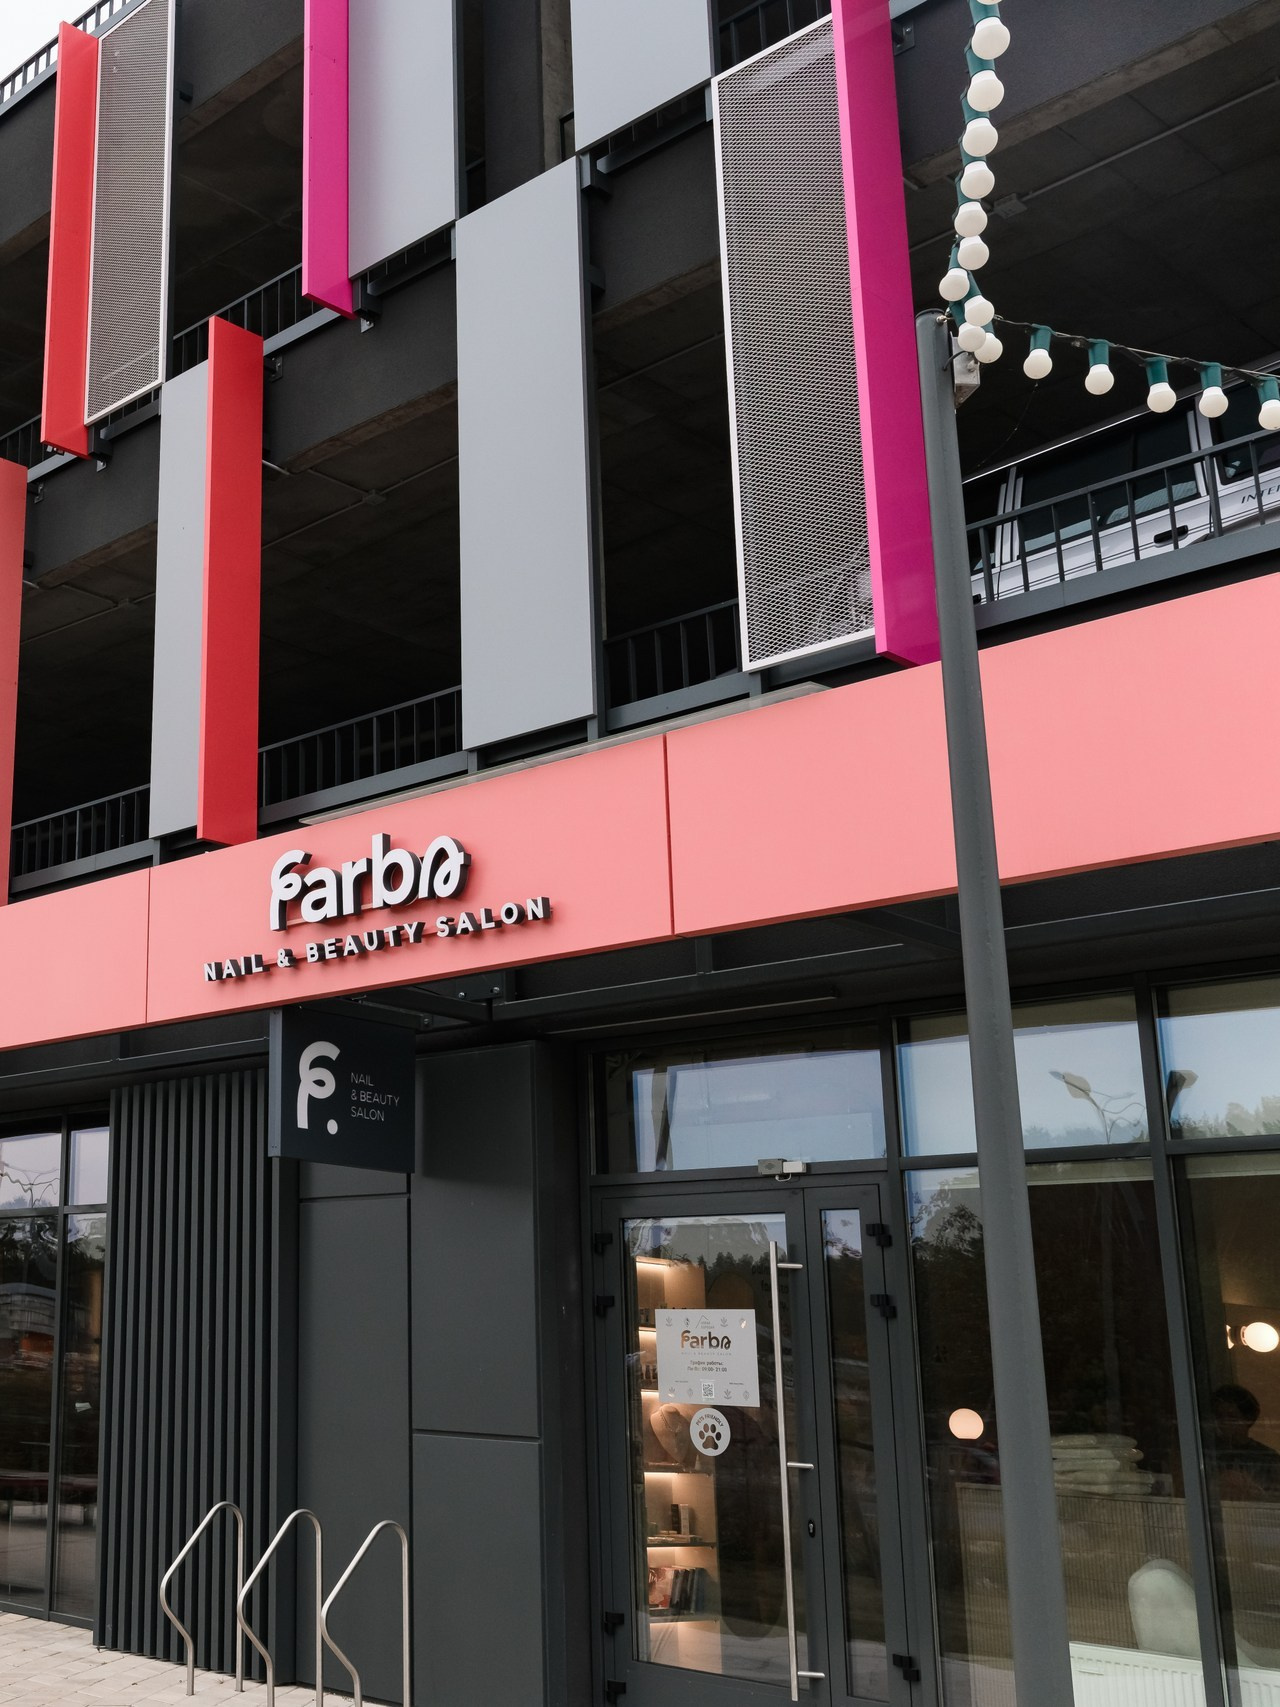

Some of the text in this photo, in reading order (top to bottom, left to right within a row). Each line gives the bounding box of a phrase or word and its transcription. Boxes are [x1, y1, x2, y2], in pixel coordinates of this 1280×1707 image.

[203, 897, 551, 982] NAIL & BEAUTY SALON
[350, 1072, 375, 1087] NAIL
[350, 1089, 400, 1107] & BEAUTY
[350, 1105, 385, 1122] SALON
[695, 1413, 724, 1427] PETS FRIENDLY
